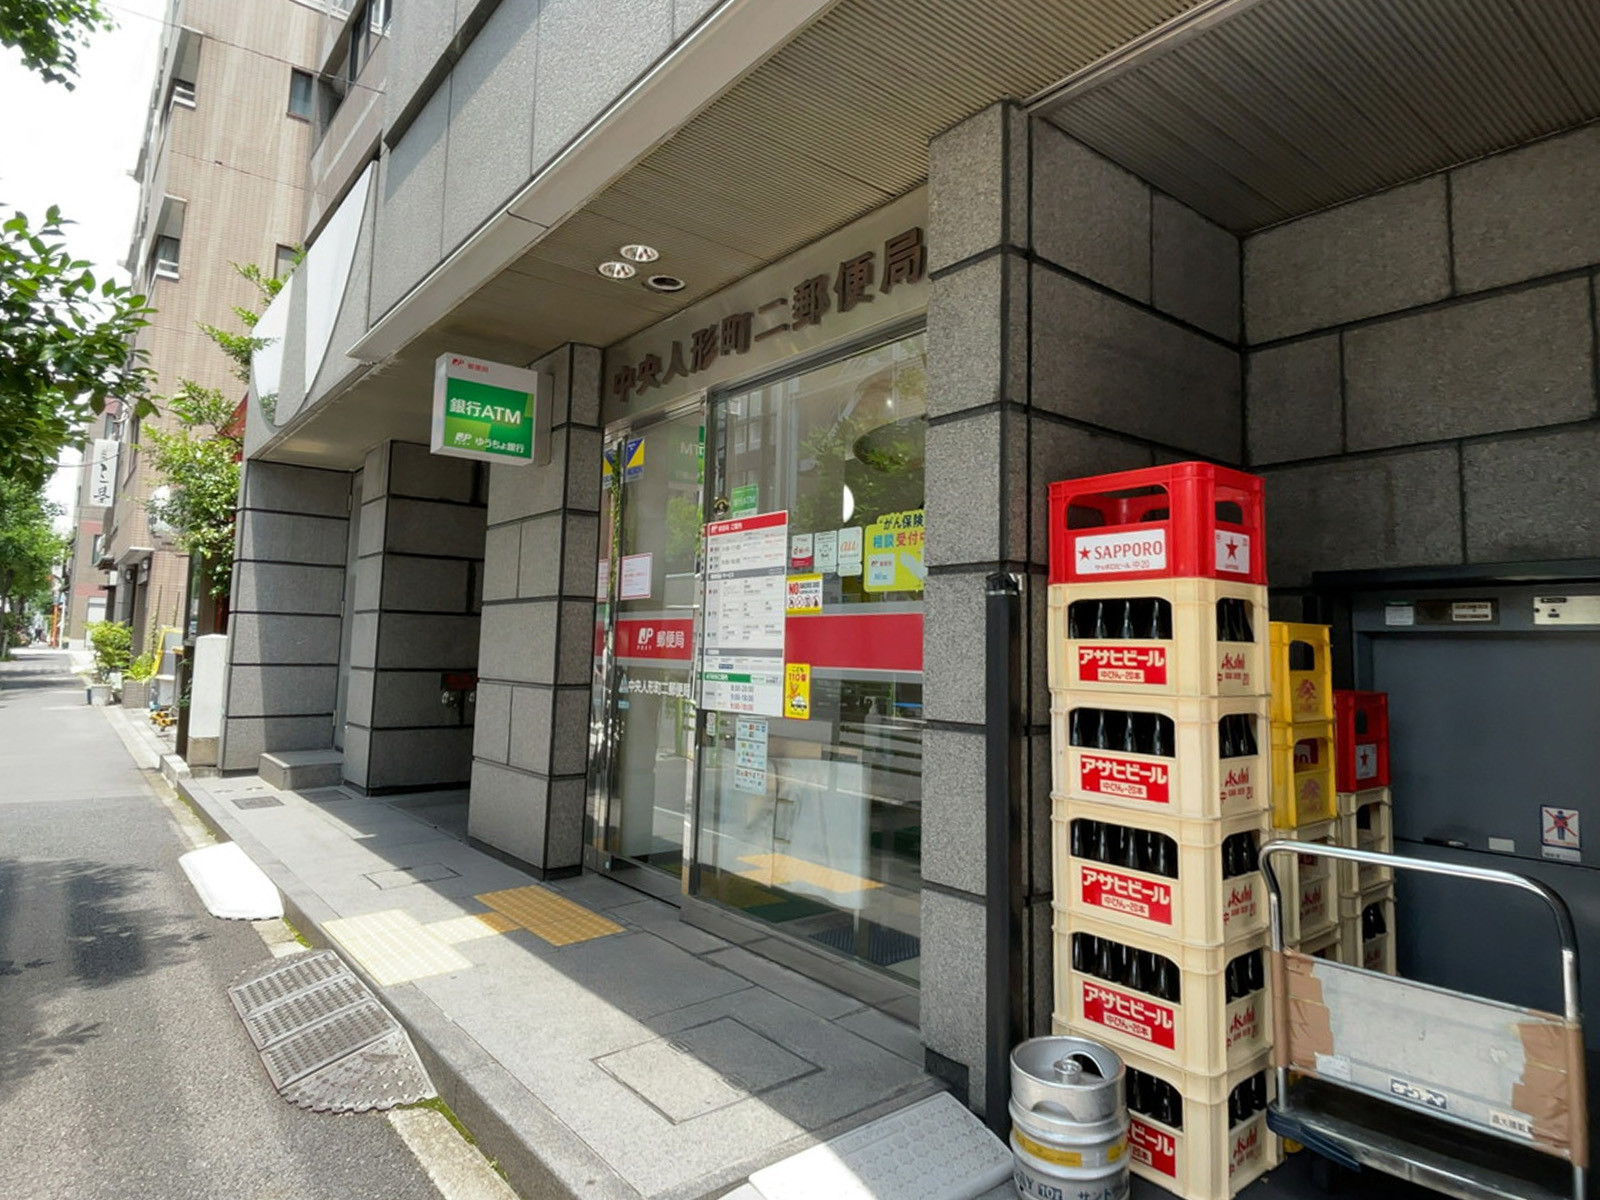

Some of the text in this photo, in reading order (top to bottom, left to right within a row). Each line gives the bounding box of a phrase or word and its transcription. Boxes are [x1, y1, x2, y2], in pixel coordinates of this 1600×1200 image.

[614, 226, 928, 401] 中央人形町二郵便局
[449, 397, 521, 424] 銀行ATM
[475, 437, 525, 453] ゆうちょ銀行
[1094, 540, 1163, 560] SAPPORO
[656, 630, 685, 649] 郵便局
[1079, 648, 1165, 667] アサヒビール
[1081, 757, 1168, 785] アサヒビール
[1082, 869, 1170, 905] アサヒビール
[1084, 984, 1173, 1030] アサヒビール
[1127, 1122, 1174, 1157] ビール
